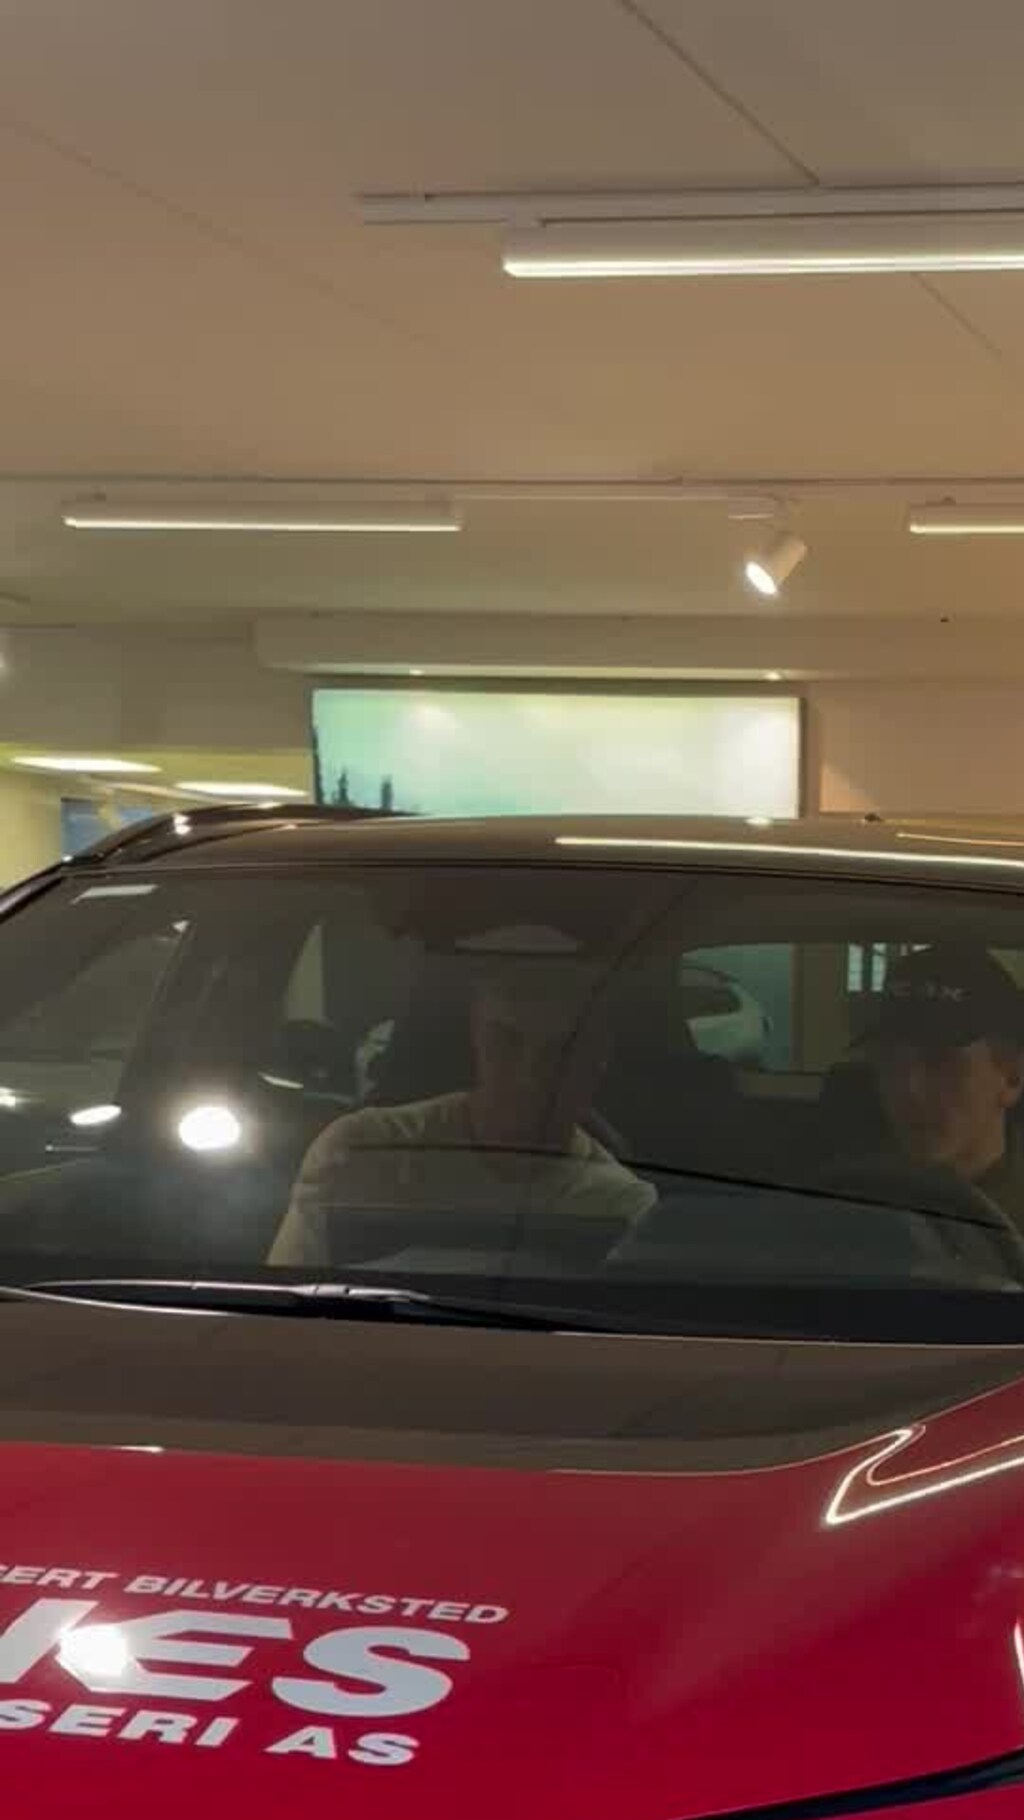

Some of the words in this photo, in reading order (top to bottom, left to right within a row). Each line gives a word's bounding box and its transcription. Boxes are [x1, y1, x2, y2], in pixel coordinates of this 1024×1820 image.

[0, 1563, 120, 1590] ERT
[124, 1575, 510, 1625] BILVERKSTED
[264, 1725, 420, 1766] AS
